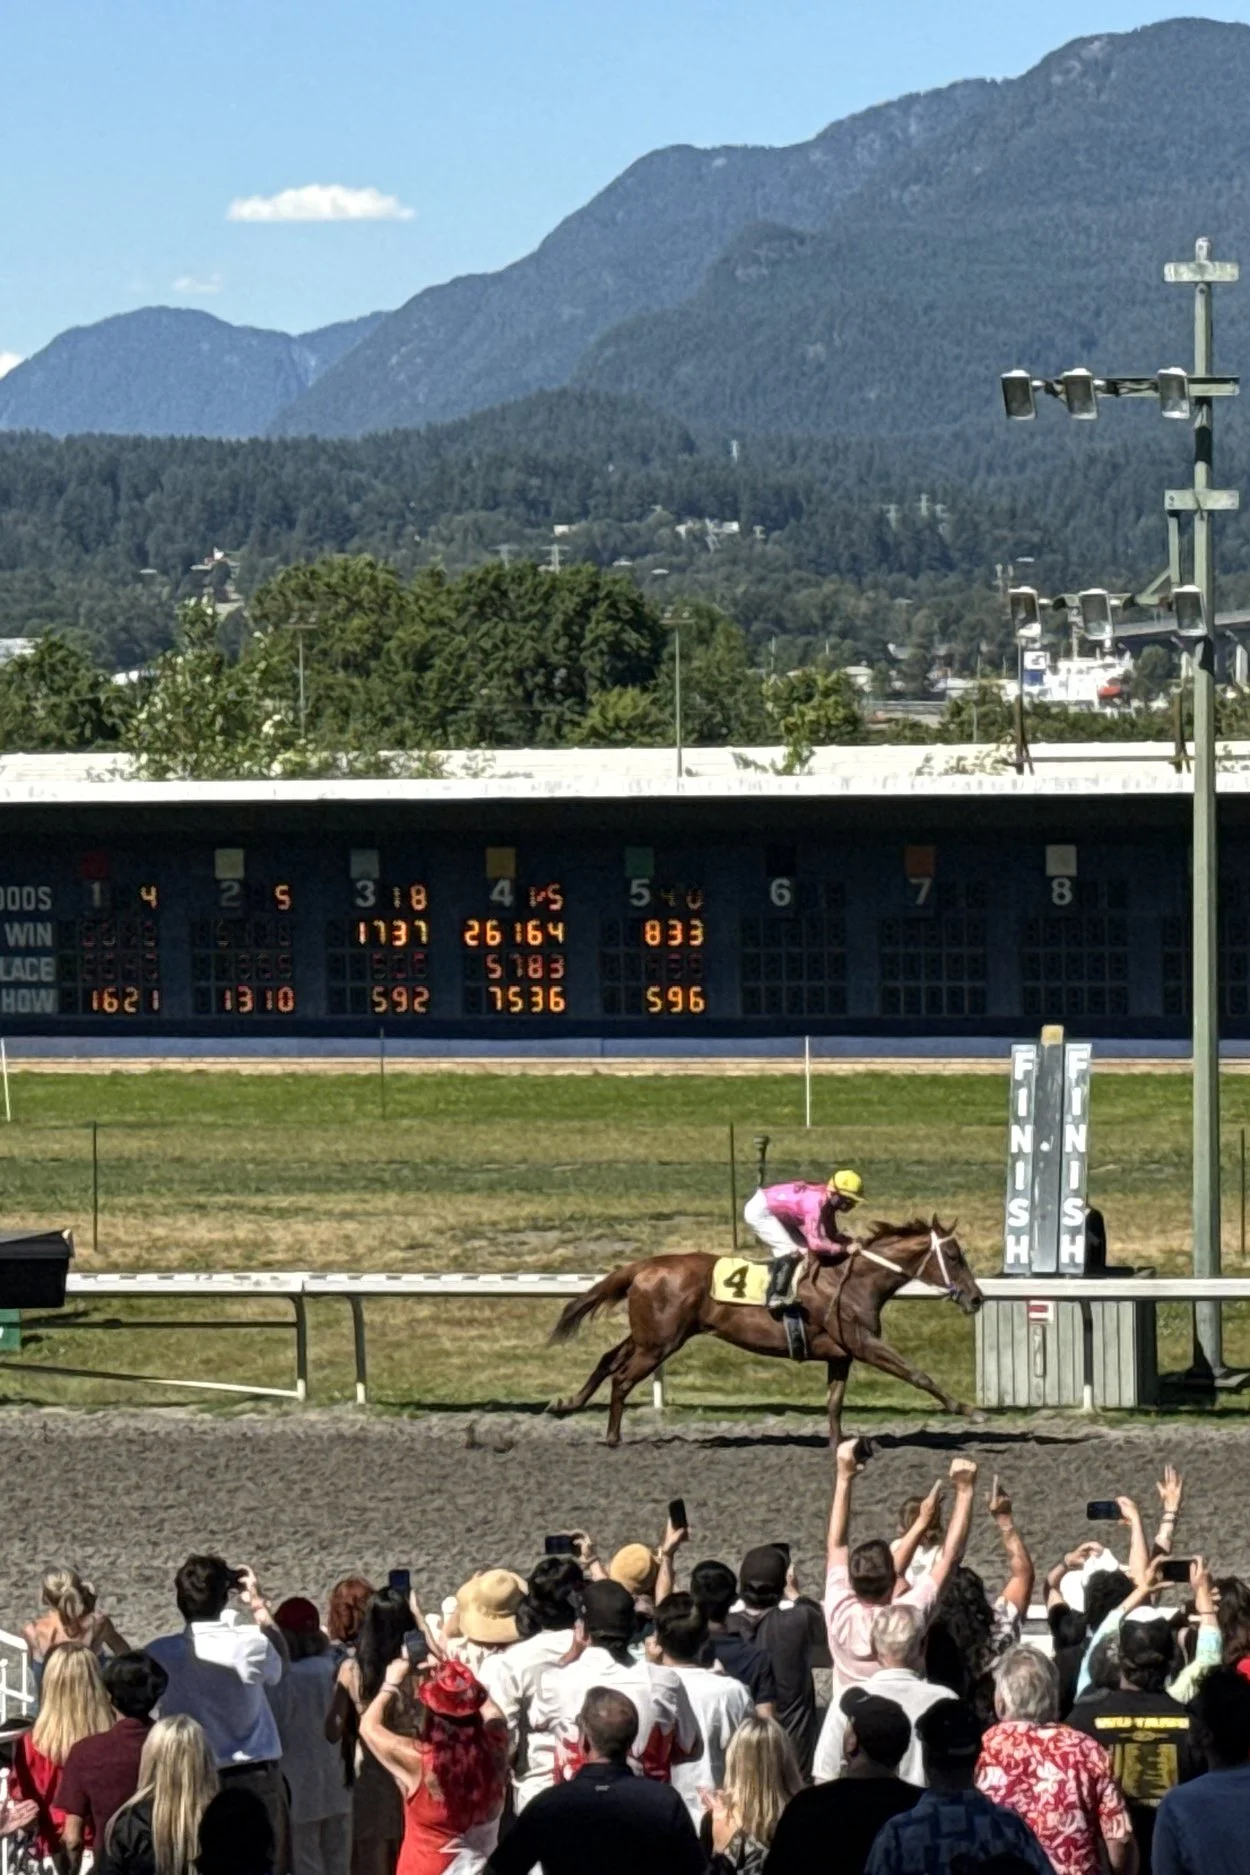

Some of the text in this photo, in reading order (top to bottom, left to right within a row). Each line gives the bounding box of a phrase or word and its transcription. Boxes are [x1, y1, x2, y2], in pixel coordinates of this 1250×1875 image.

[91, 882, 107, 906] 1
[140, 885, 159, 909] 4
[219, 882, 241, 907] 2
[273, 884, 292, 910] 5
[355, 880, 376, 907] 3
[392, 883, 428, 911] 18
[489, 879, 514, 907] 4
[629, 878, 651, 908] 5
[770, 878, 792, 906] 6
[909, 878, 932, 905] 7
[1051, 877, 1073, 906] 8
[5, 922, 53, 947] WIN
[643, 918, 705, 947] 833
[91, 986, 160, 1013] 1621
[224, 986, 295, 1013] 1310
[371, 985, 430, 1013] 592
[488, 985, 566, 1013] 7536
[645, 985, 706, 1014] 596
[1006, 1051, 1035, 1265] FINISH
[1060, 1051, 1089, 1265] FINISH
[724, 1265, 749, 1298] 4
